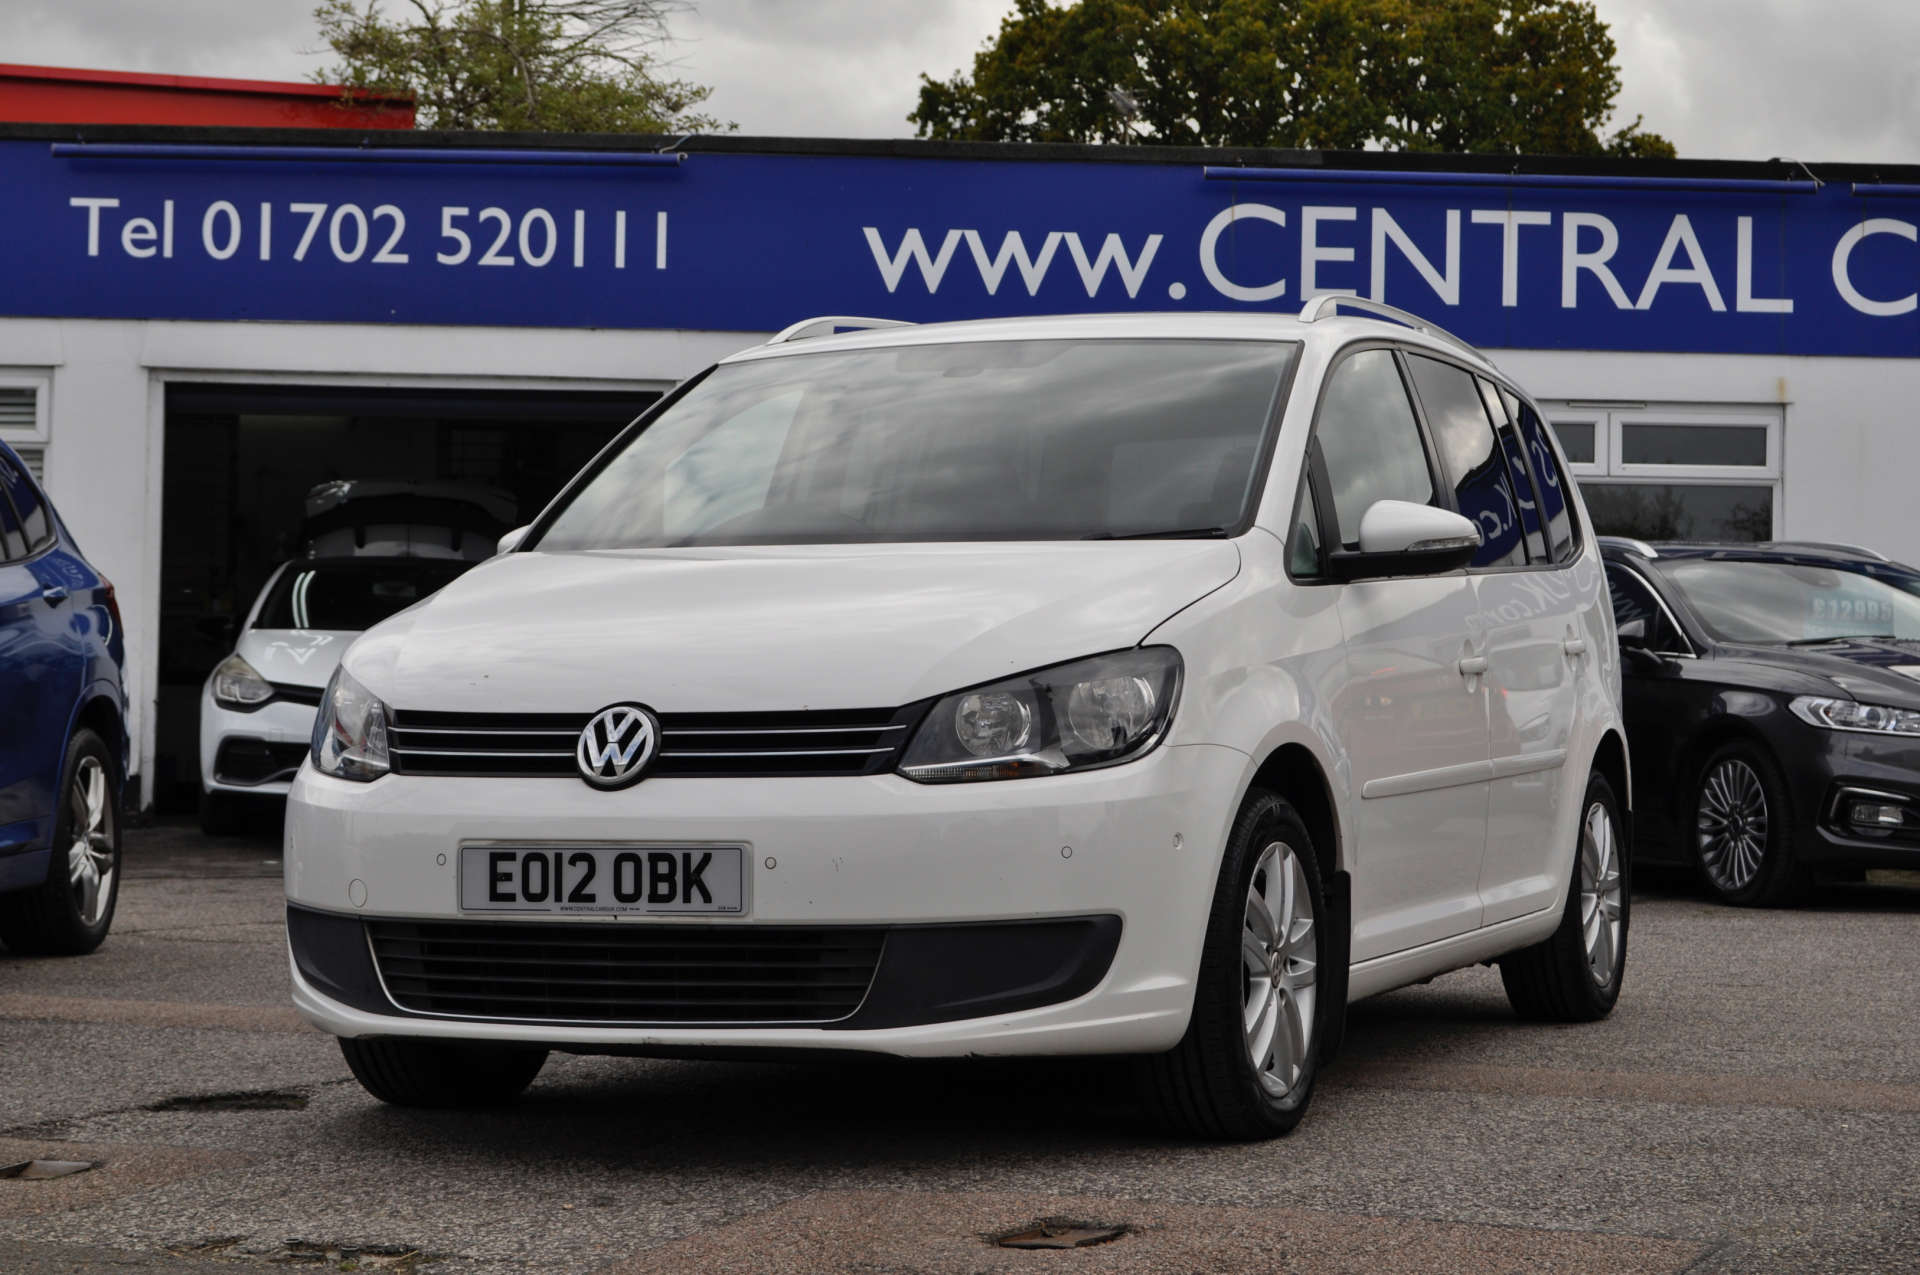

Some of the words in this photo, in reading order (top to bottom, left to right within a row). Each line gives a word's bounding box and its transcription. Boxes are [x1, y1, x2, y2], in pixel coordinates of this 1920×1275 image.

[70, 198, 174, 258] Tel
[202, 201, 409, 264] 01702
[436, 206, 668, 270] 520111
